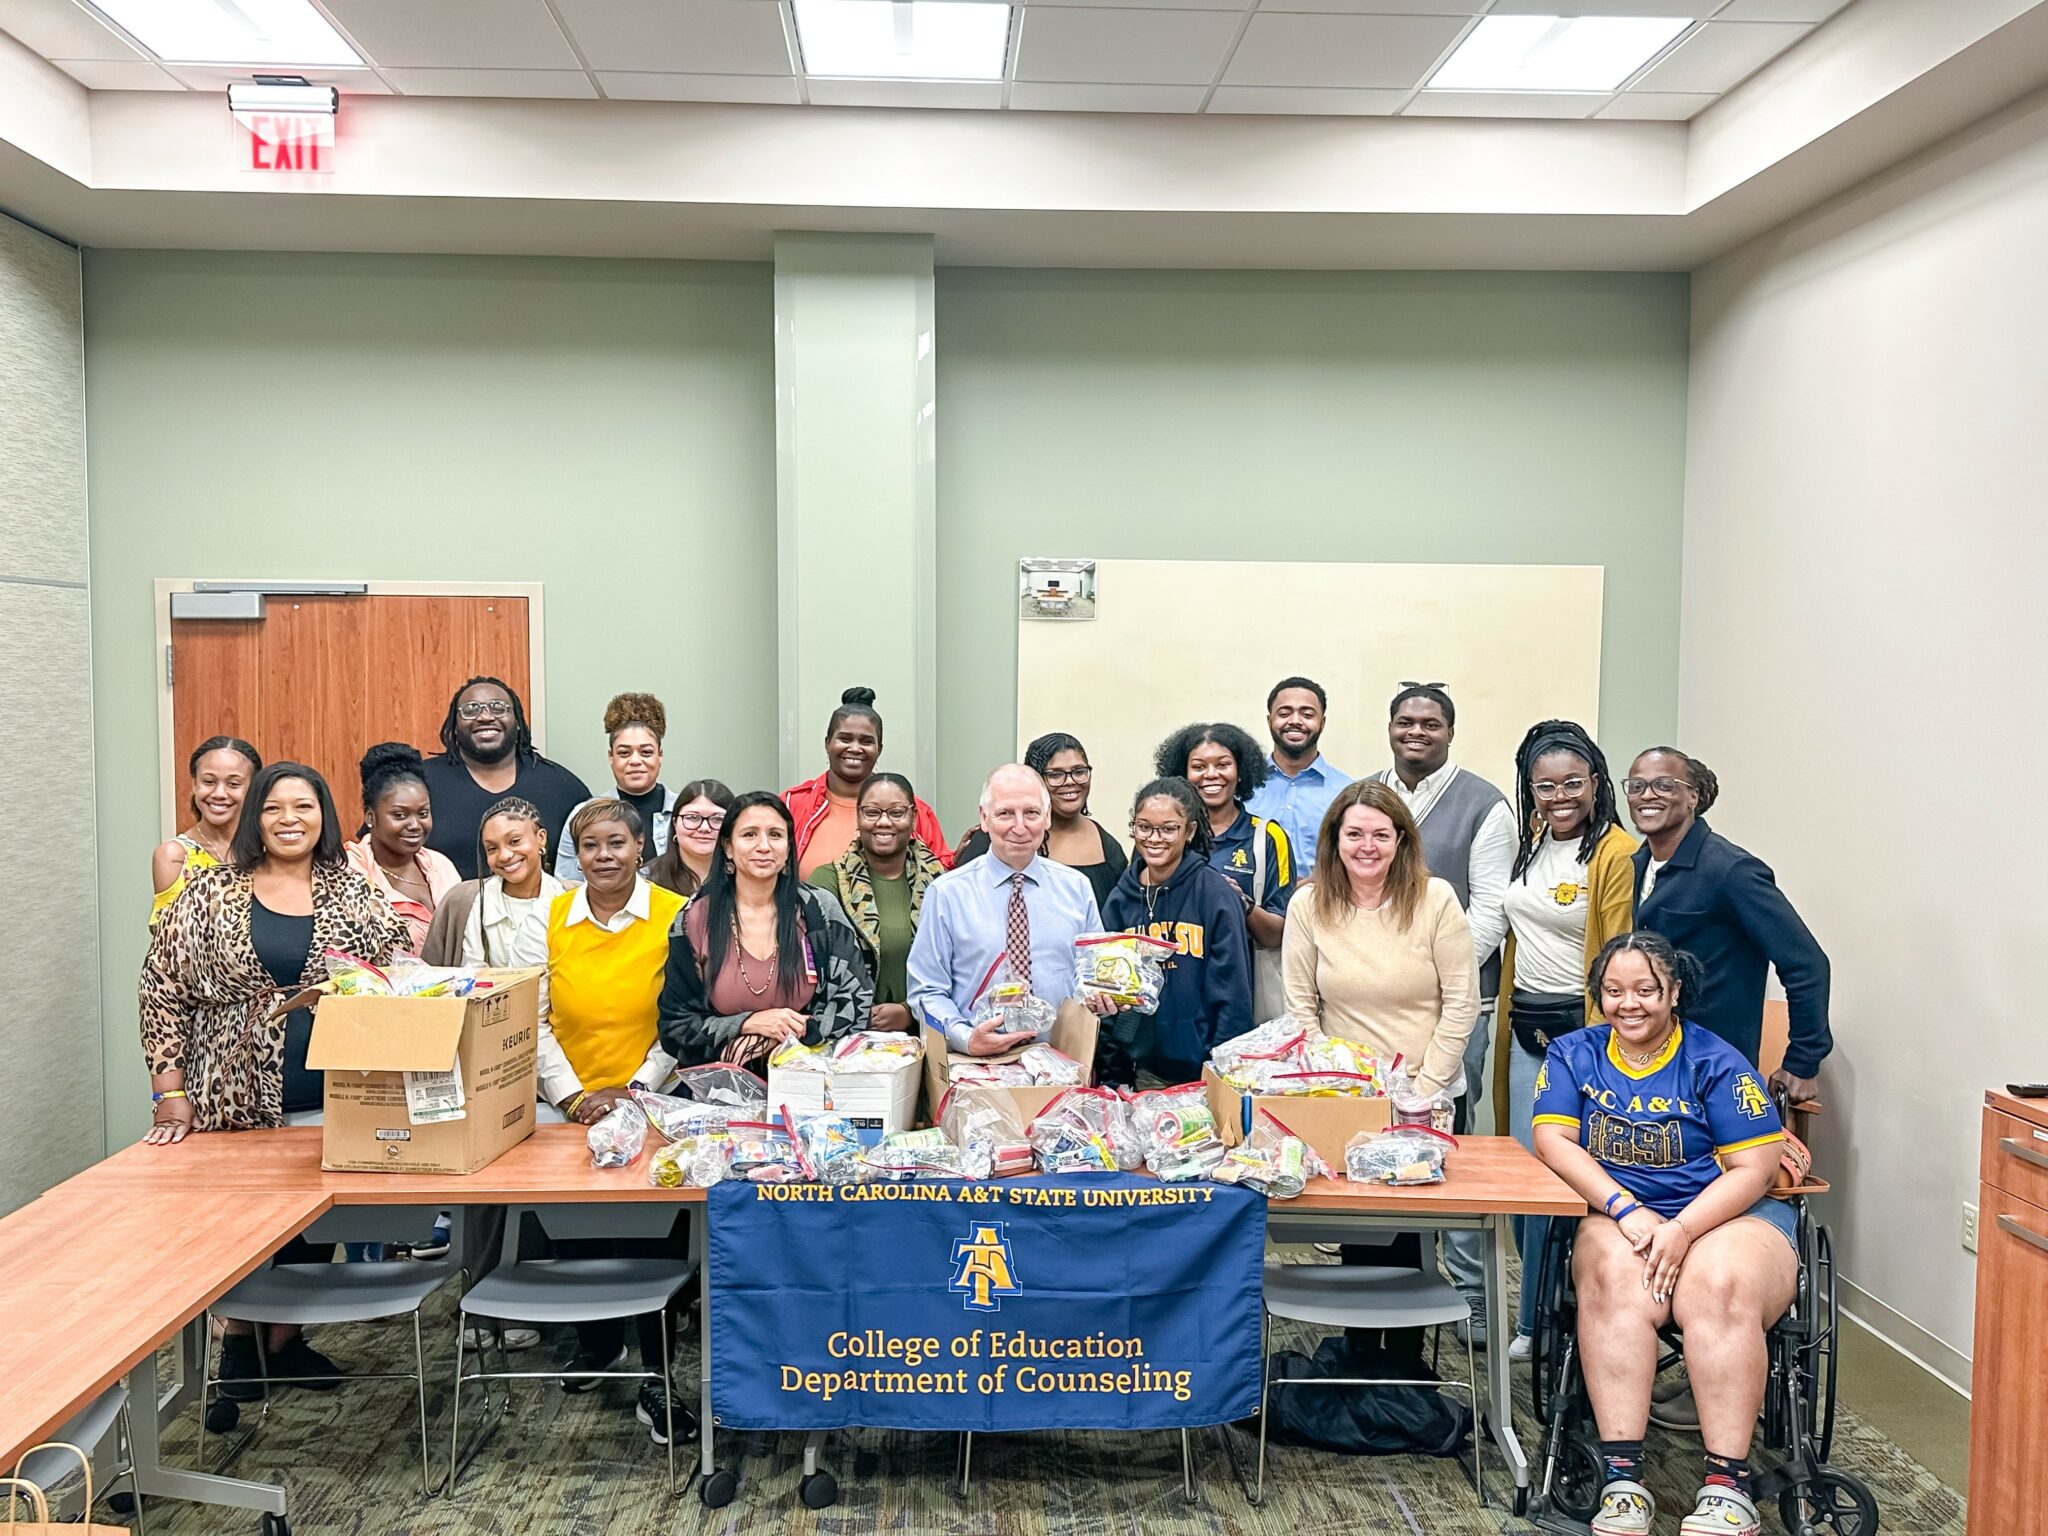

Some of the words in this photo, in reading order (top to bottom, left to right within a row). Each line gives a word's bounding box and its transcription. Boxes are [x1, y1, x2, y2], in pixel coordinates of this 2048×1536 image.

[252, 115, 322, 170] EXIT
[502, 1027, 531, 1052] KEURIG
[1587, 1109, 1687, 1168] 1891
[756, 1183, 834, 1201] NORTH
[840, 1184, 952, 1201] CAROLINA
[957, 1186, 1004, 1203] A&T
[1009, 1187, 1076, 1207] STATE
[1082, 1187, 1215, 1207] UNIVERSITY
[827, 1329, 940, 1367] College
[950, 1329, 983, 1358] of
[989, 1330, 1144, 1359] Education
[780, 1364, 968, 1401] Department
[977, 1364, 1009, 1395] of
[1015, 1363, 1192, 1401] Counseling
